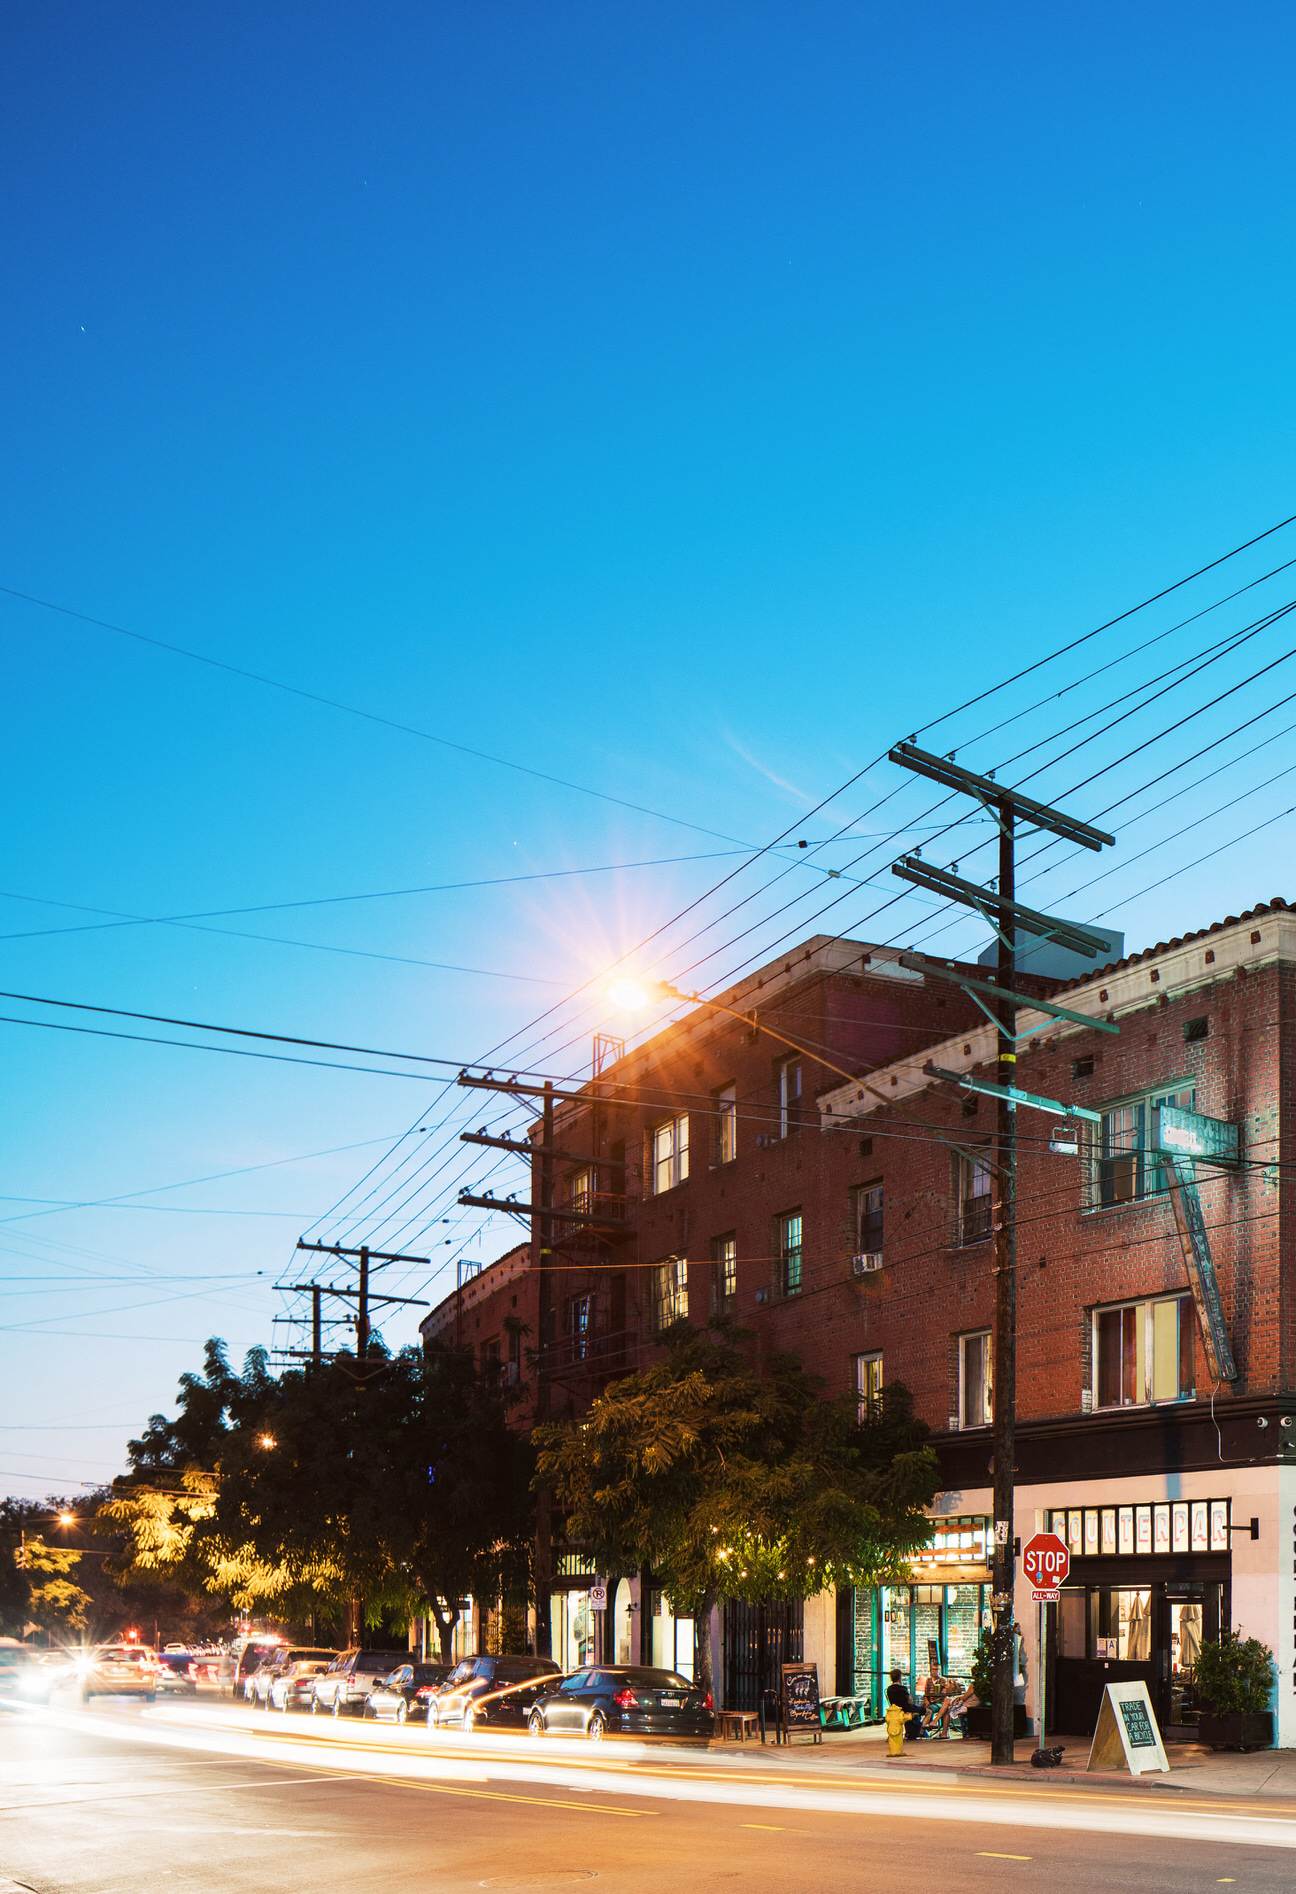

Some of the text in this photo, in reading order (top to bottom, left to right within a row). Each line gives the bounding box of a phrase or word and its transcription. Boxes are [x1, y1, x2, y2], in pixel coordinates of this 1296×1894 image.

[1053, 1510, 1227, 1544] COUNTERPAR
[1026, 1551, 1066, 1572] STOP
[1032, 1592, 1059, 1600] ALL-WAY
[1109, 1640, 1115, 1649] A
[1120, 1702, 1141, 1712] TRADE
[1123, 1712, 1144, 1721] IN YOUR
[1126, 1721, 1150, 1732] CAR FOR
[1129, 1731, 1153, 1741] A BICYCLE
